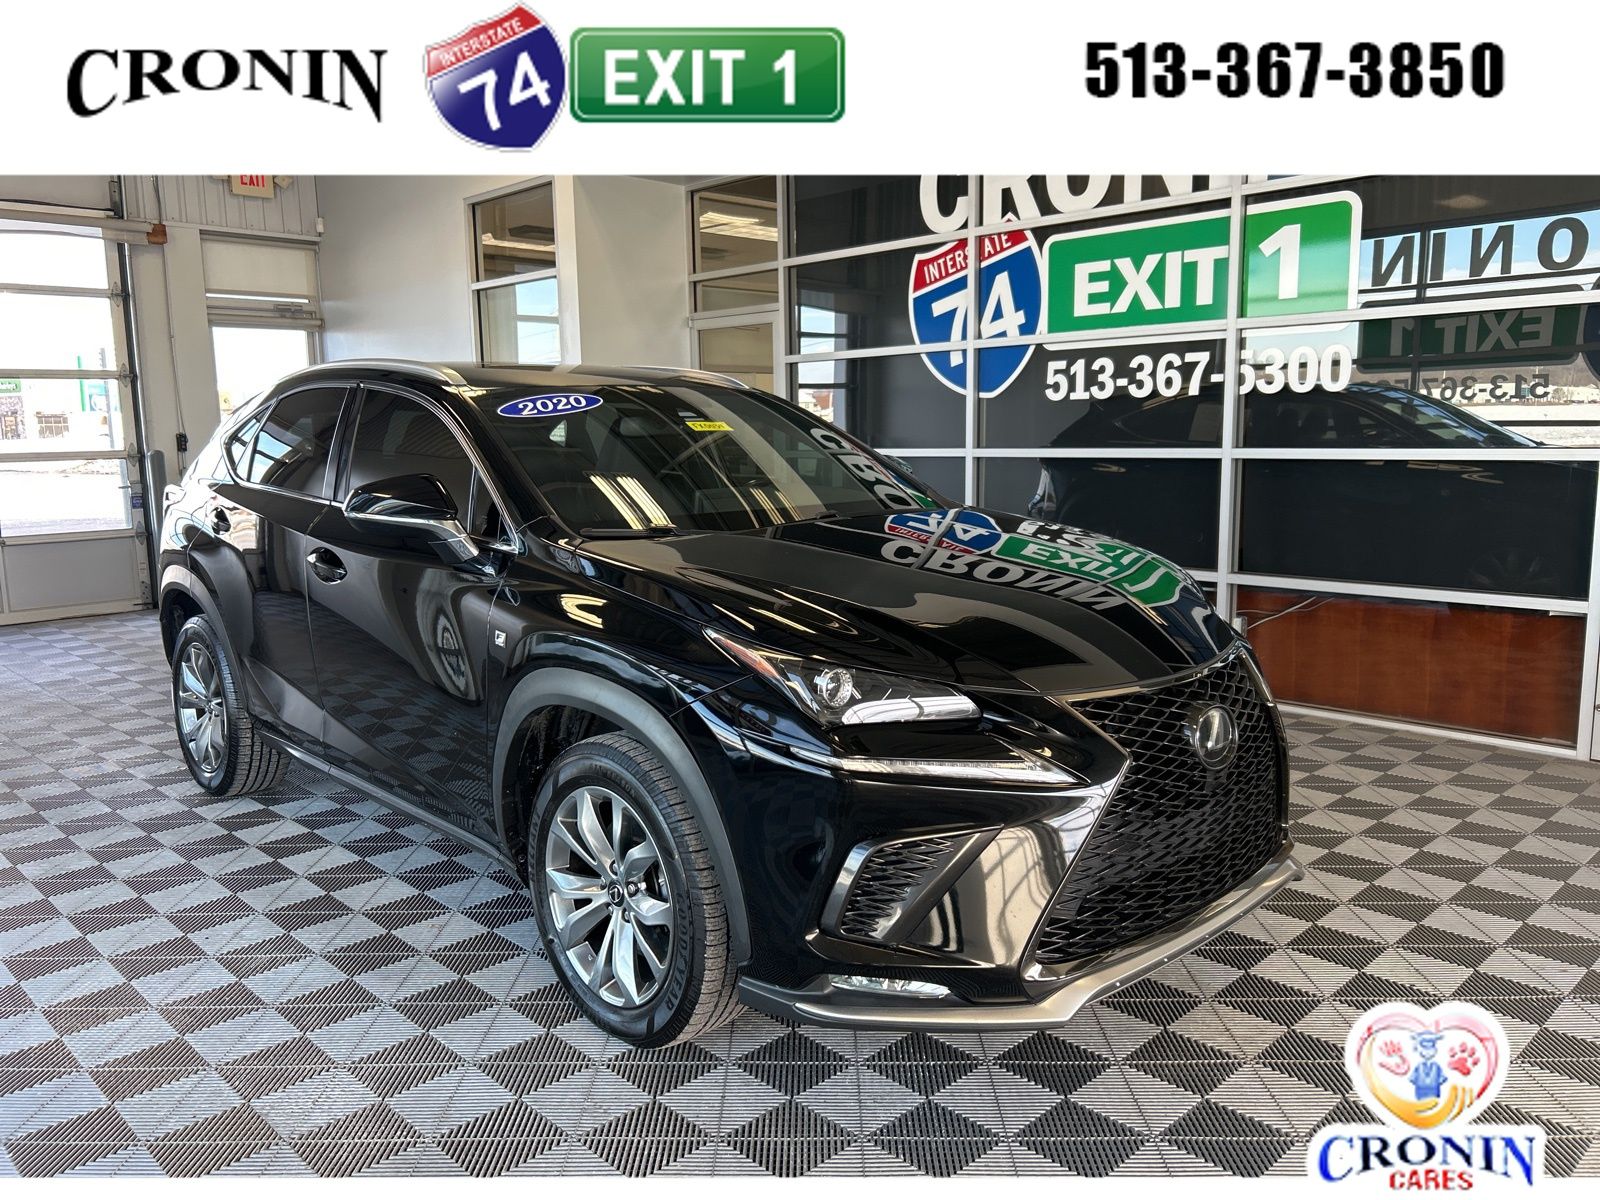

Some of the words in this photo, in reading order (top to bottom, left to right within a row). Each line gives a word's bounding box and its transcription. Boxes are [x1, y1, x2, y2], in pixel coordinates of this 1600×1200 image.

[923, 232, 1013, 284] INTERSATE
[1073, 245, 1229, 317] EXIT
[1258, 223, 1302, 300] 1
[931, 271, 1026, 367] 74
[518, 396, 587, 415] 2020
